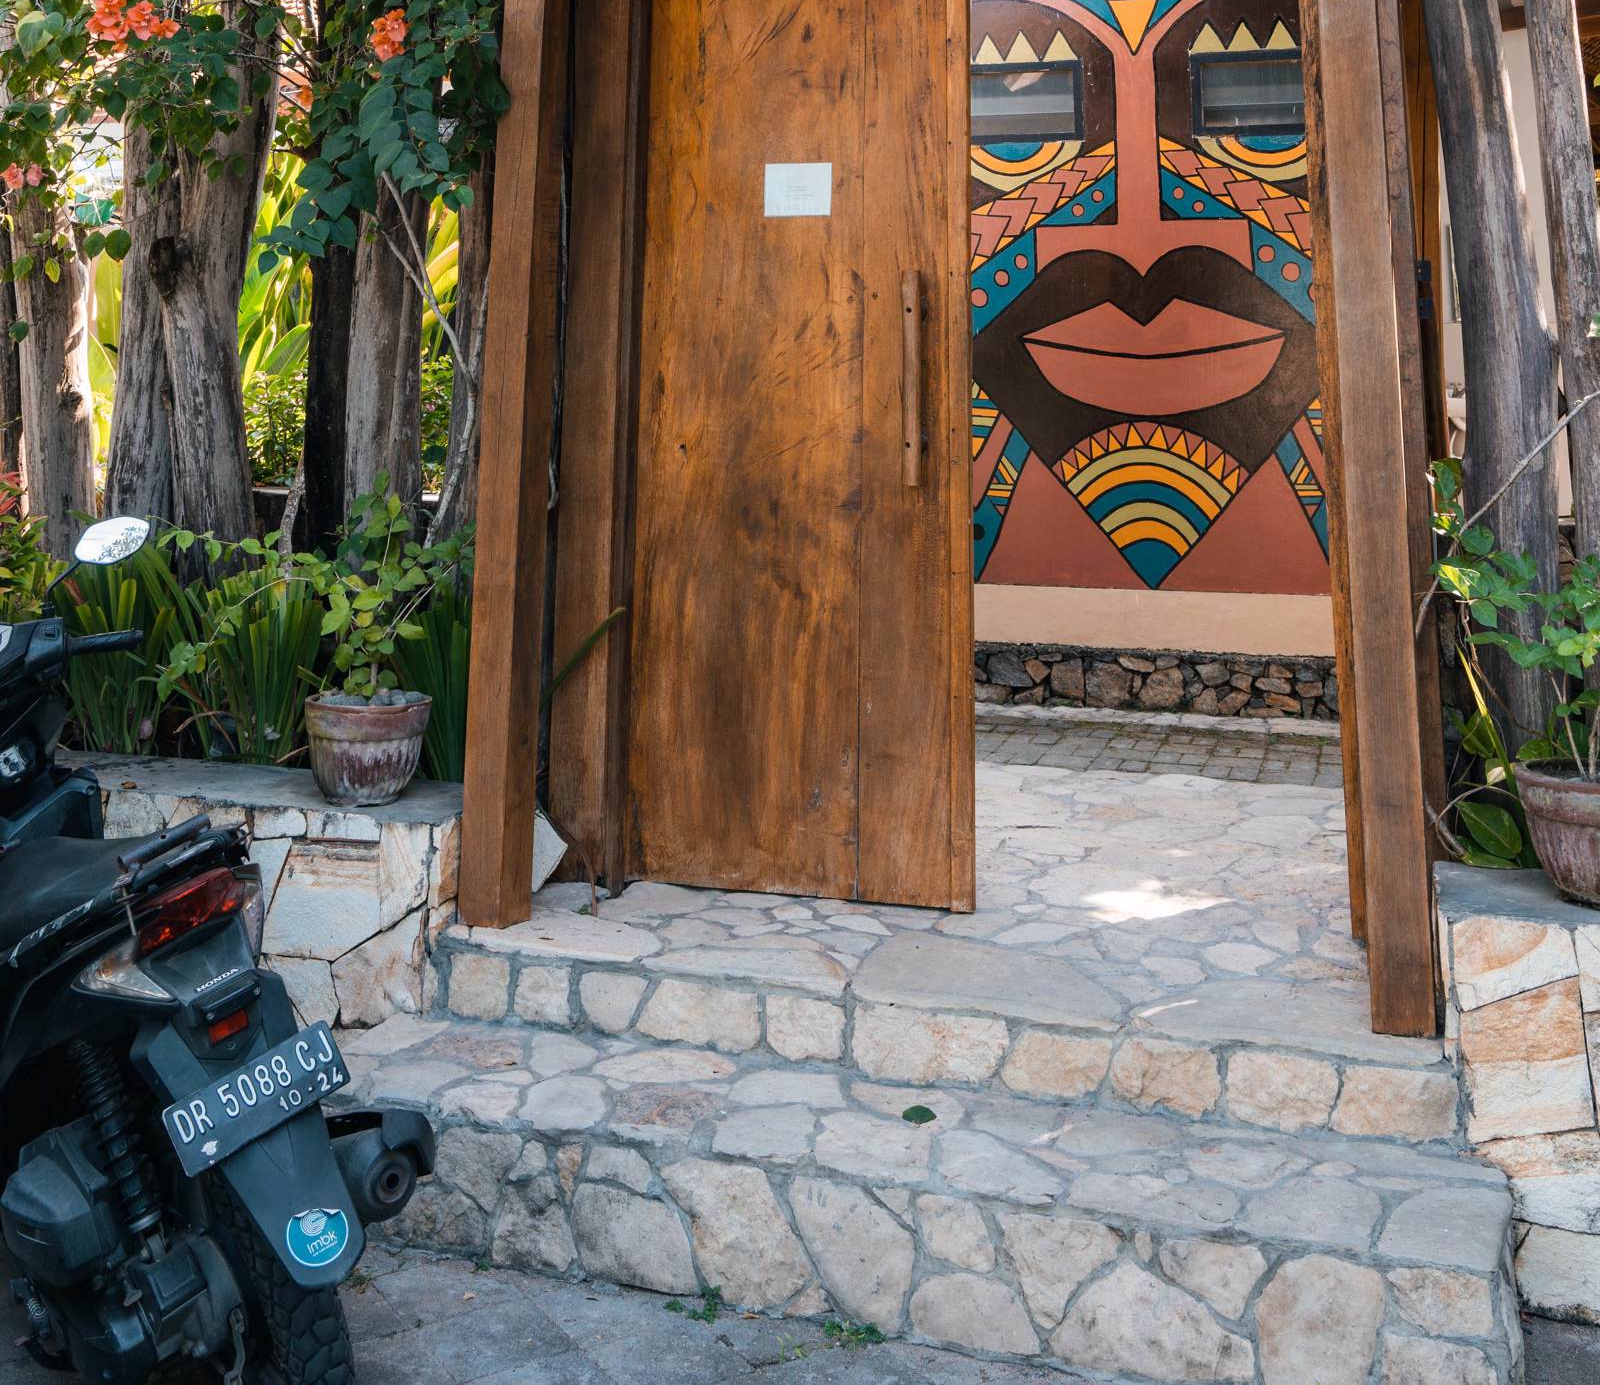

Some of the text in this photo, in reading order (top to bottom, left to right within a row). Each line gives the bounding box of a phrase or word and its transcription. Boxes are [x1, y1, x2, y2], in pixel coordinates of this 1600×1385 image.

[196, 968, 239, 992] HONDA
[172, 1030, 333, 1144] DR 5088 CJ
